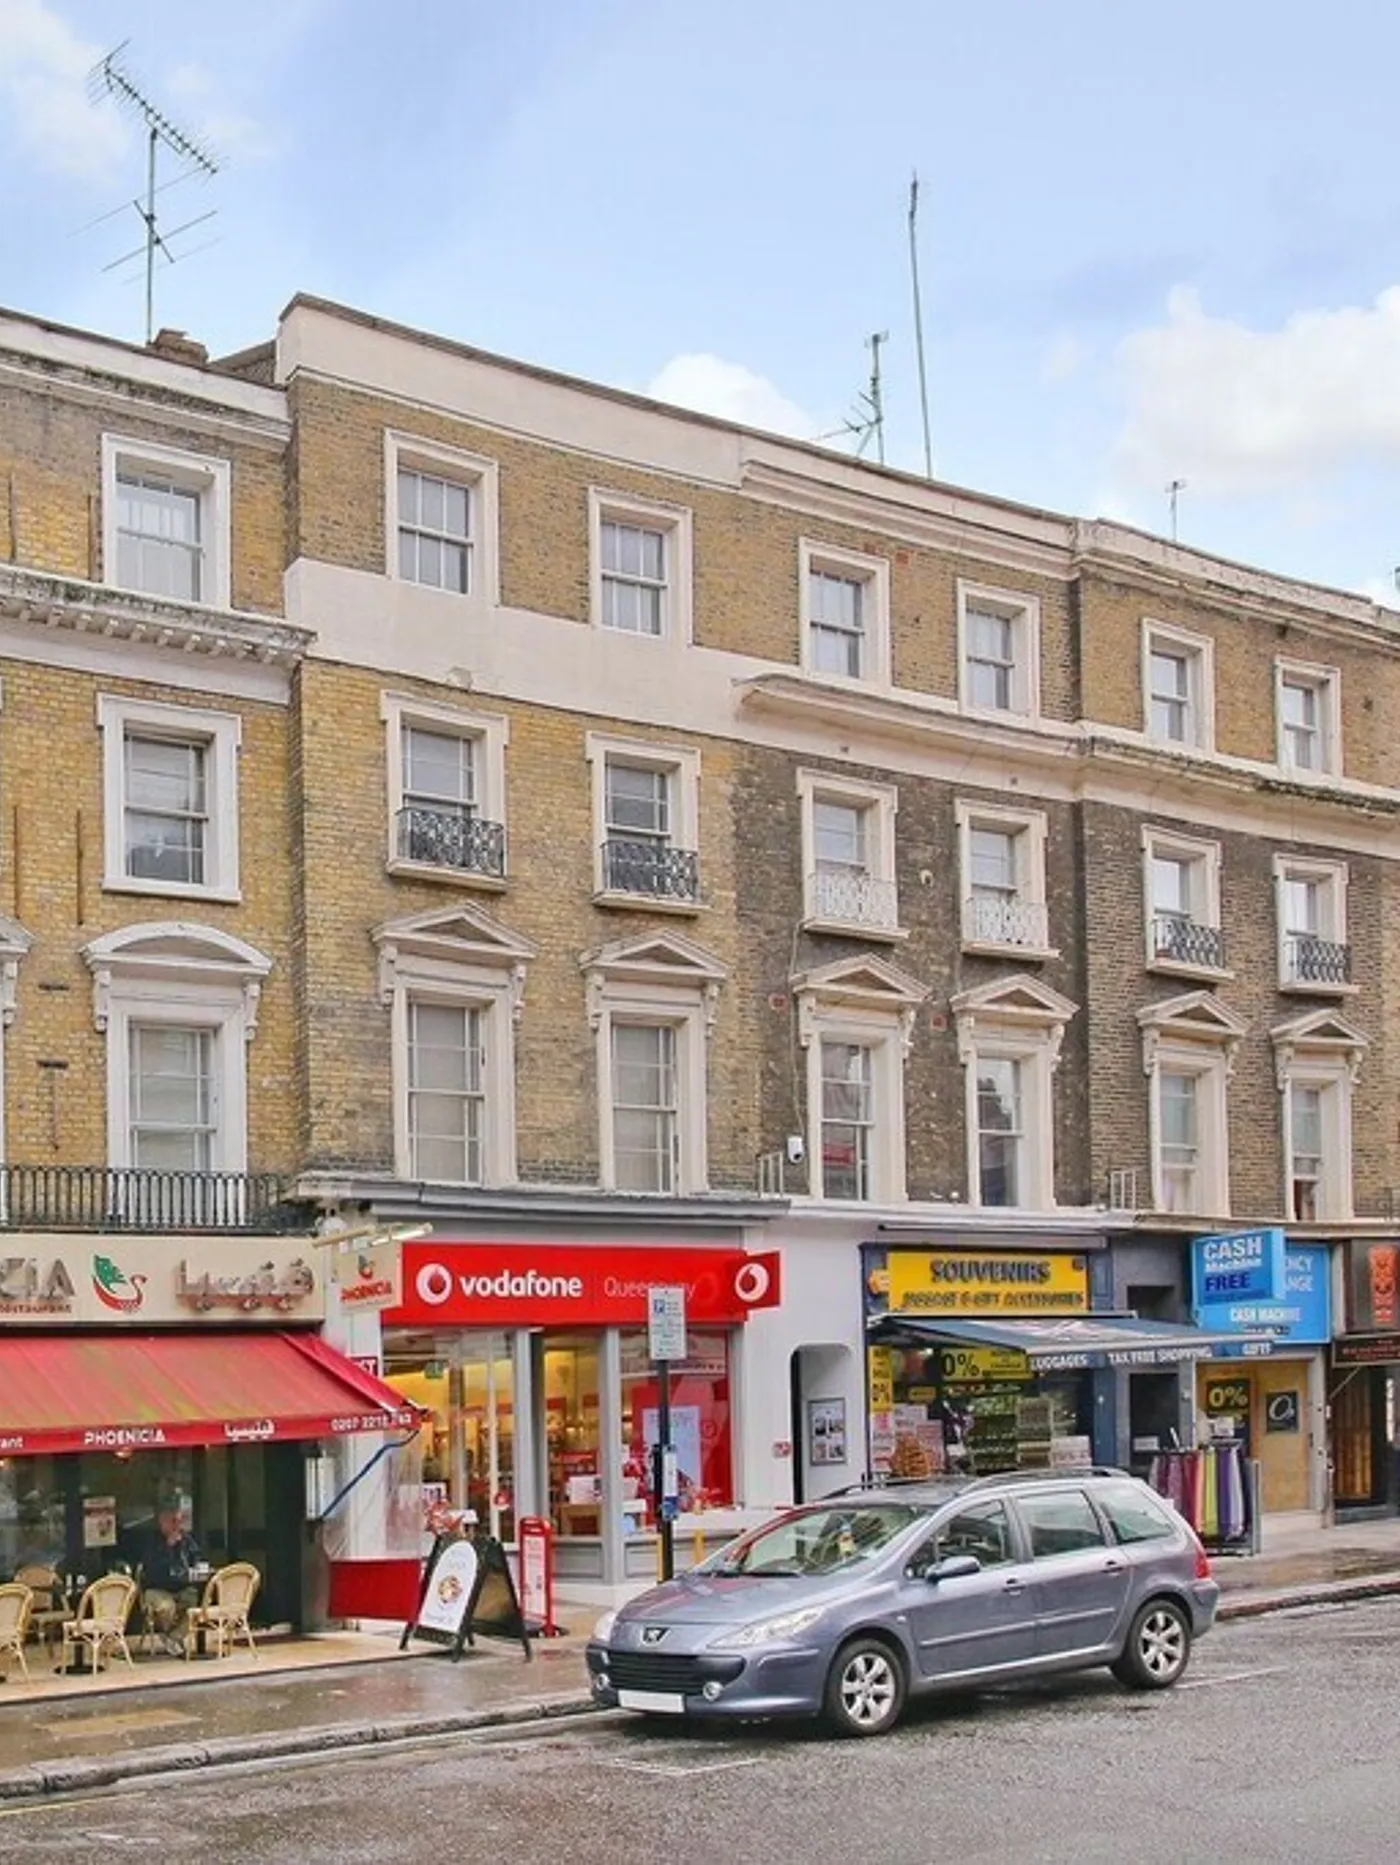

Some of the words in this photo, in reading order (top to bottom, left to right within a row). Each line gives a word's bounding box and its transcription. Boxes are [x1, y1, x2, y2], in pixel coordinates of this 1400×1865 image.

[1204, 1236, 1262, 1259] CASH
[930, 1258, 1050, 1284] SOUVENIRS
[1206, 1272, 1250, 1291] FREE
[460, 1269, 583, 1297] vodafone
[603, 1276, 697, 1303] Queey
[84, 1429, 166, 1446] PHOENICIA
